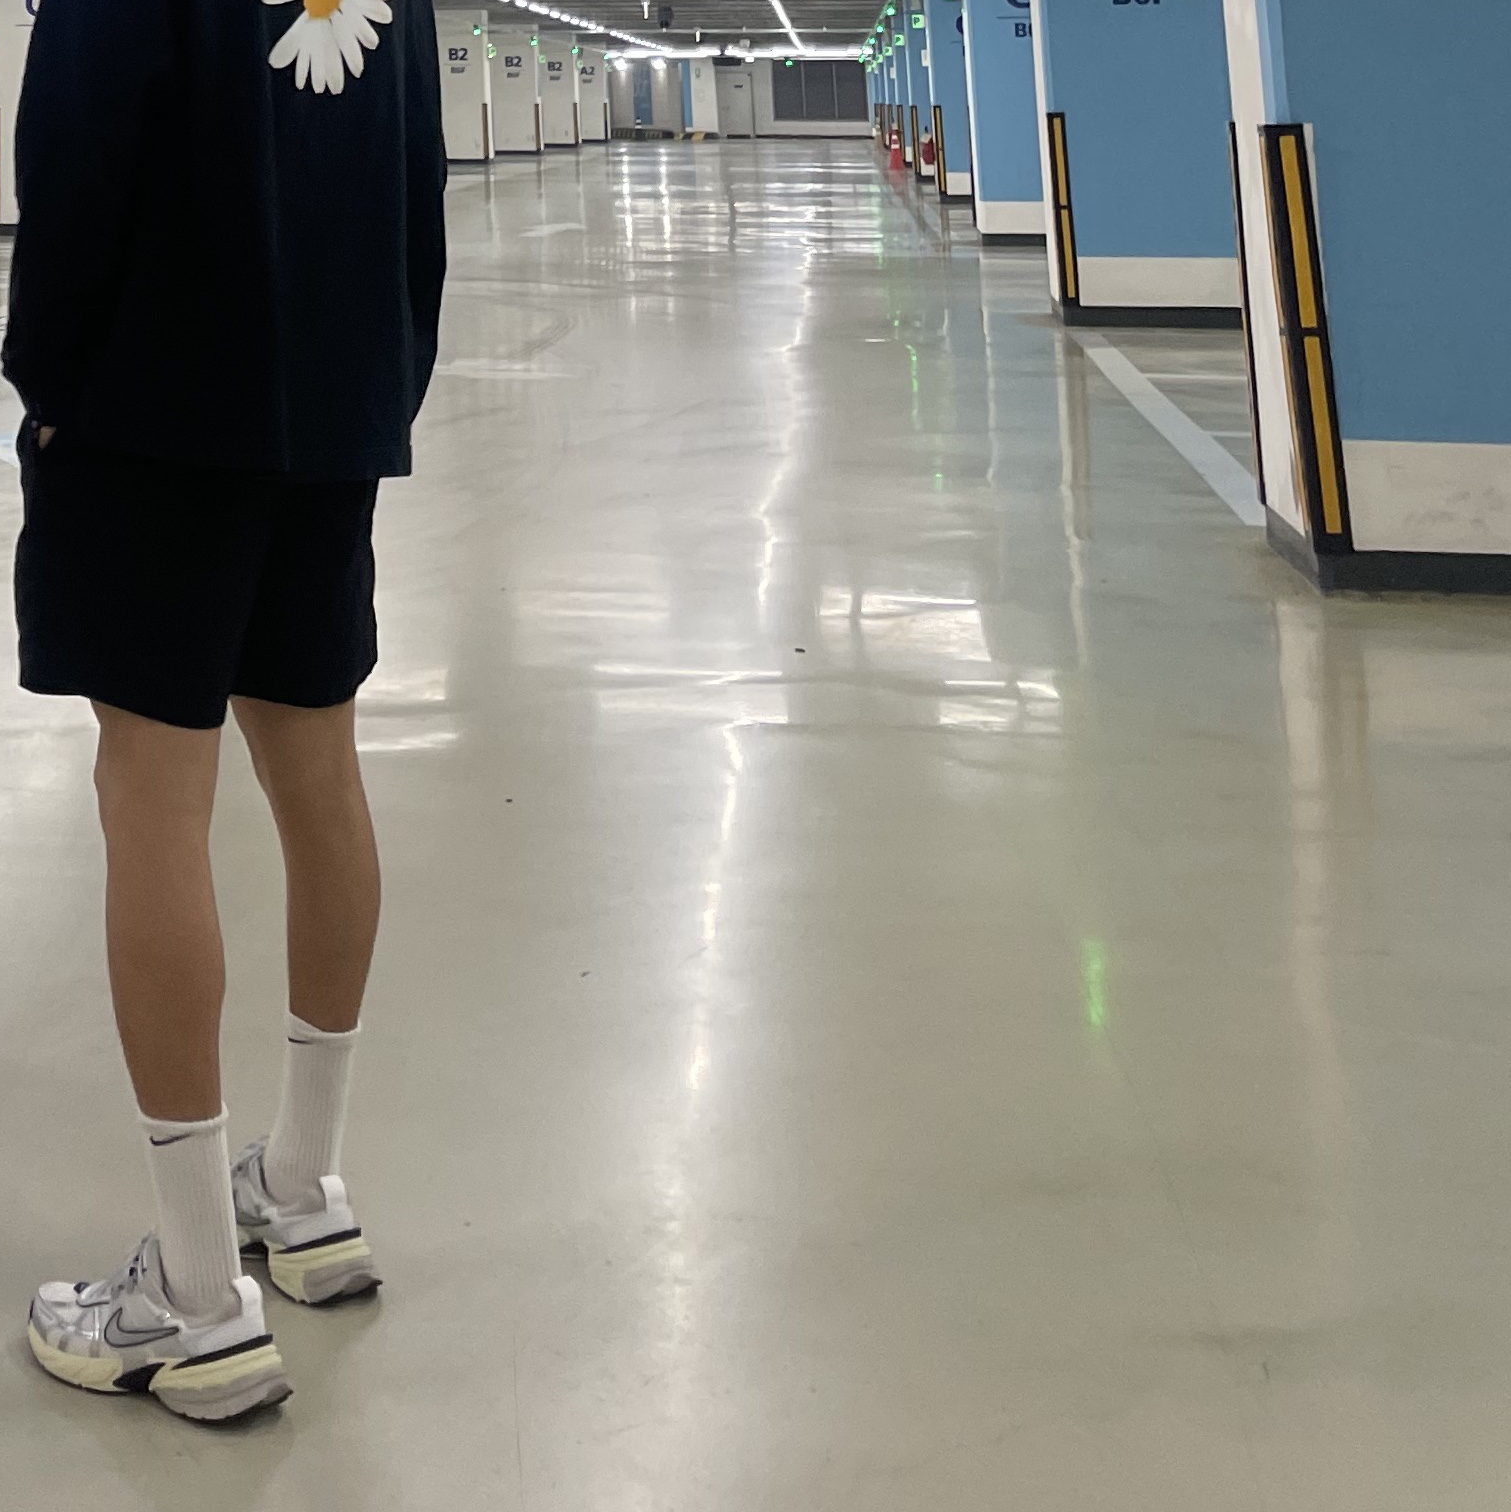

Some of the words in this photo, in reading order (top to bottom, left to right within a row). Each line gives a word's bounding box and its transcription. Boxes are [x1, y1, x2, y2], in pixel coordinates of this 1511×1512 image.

[1014, 22, 1033, 38] B
[448, 47, 468, 61] B2
[505, 56, 522, 68] B2
[547, 61, 563, 72] B2
